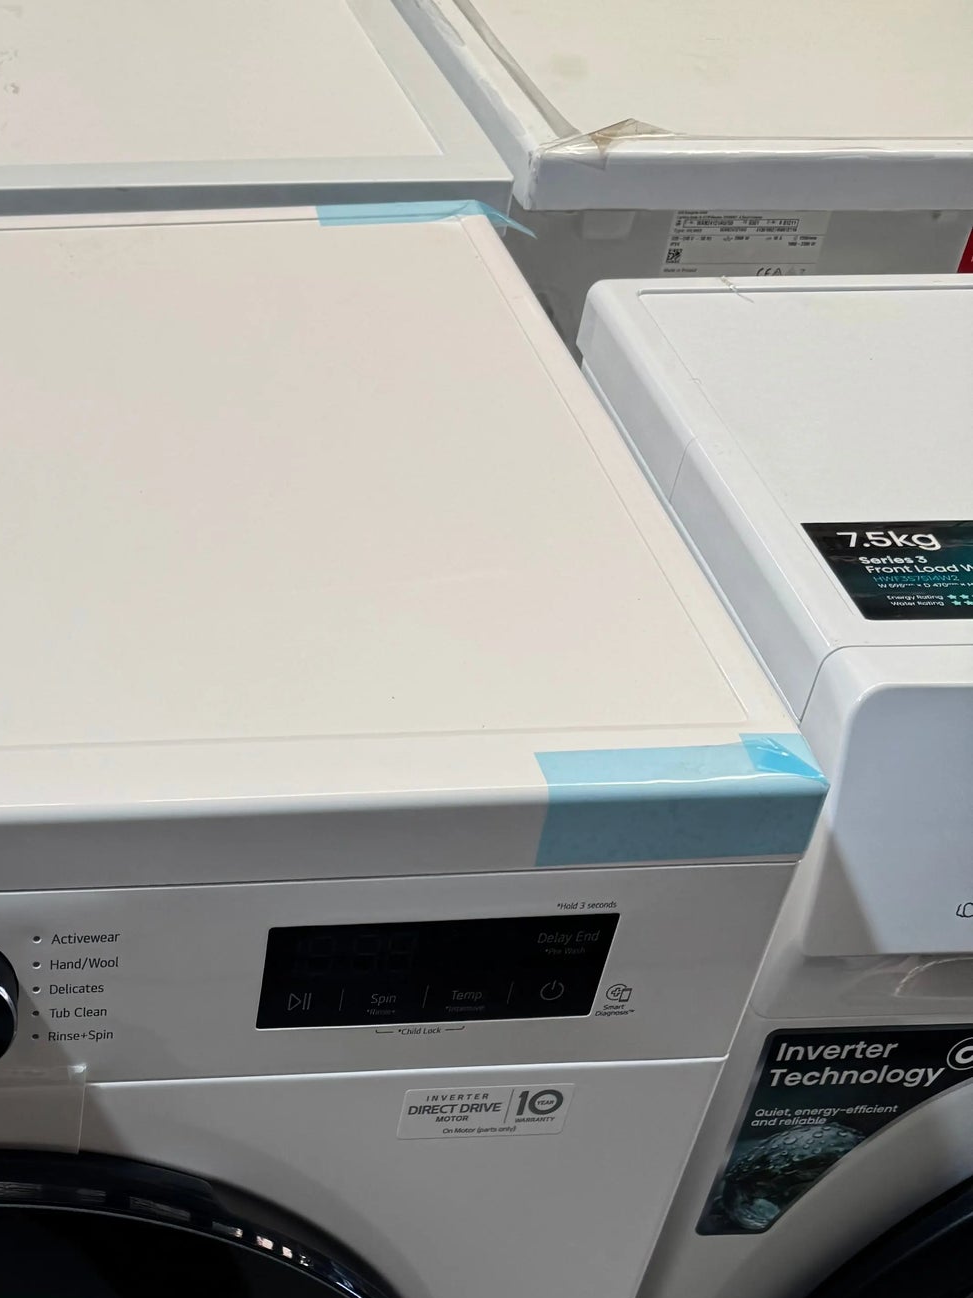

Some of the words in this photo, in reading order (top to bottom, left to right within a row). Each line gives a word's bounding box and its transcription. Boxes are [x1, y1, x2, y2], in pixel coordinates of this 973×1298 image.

[836, 530, 942, 551] 7.5kg
[858, 555, 914, 565] Series
[915, 555, 928, 564] 3
[865, 565, 913, 574] Front
[914, 564, 960, 574] Load
[587, 901, 618, 909] seconds
[51, 931, 121, 945] Activewear
[537, 931, 573, 945] Delay
[575, 930, 601, 942] End
[50, 956, 119, 971] Hand/Wool
[49, 982, 105, 995] Delicates
[370, 994, 397, 1006] Spin
[451, 990, 483, 1002] Temp
[49, 1007, 71, 1019] Tub
[74, 1006, 108, 1018] Clean
[47, 1029, 114, 1043] Rinse+Spin
[422, 1027, 441, 1035] Lock
[776, 1041, 898, 1062] Inverter
[769, 1065, 945, 1089] Technology
[426, 1093, 490, 1102] INVERTER
[516, 1089, 564, 1116] 10
[408, 1103, 459, 1116] DIRECT
[459, 1102, 502, 1114] DRIVE
[755, 1107, 793, 1118] Quiet,
[794, 1104, 898, 1117] energy-efficient
[435, 1115, 469, 1123] MOTOR
[751, 1118, 777, 1127] and
[778, 1116, 827, 1127] reliable
[454, 1126, 476, 1134] Motor
[476, 1126, 497, 1135] (parts
[498, 1125, 516, 1134] only)
